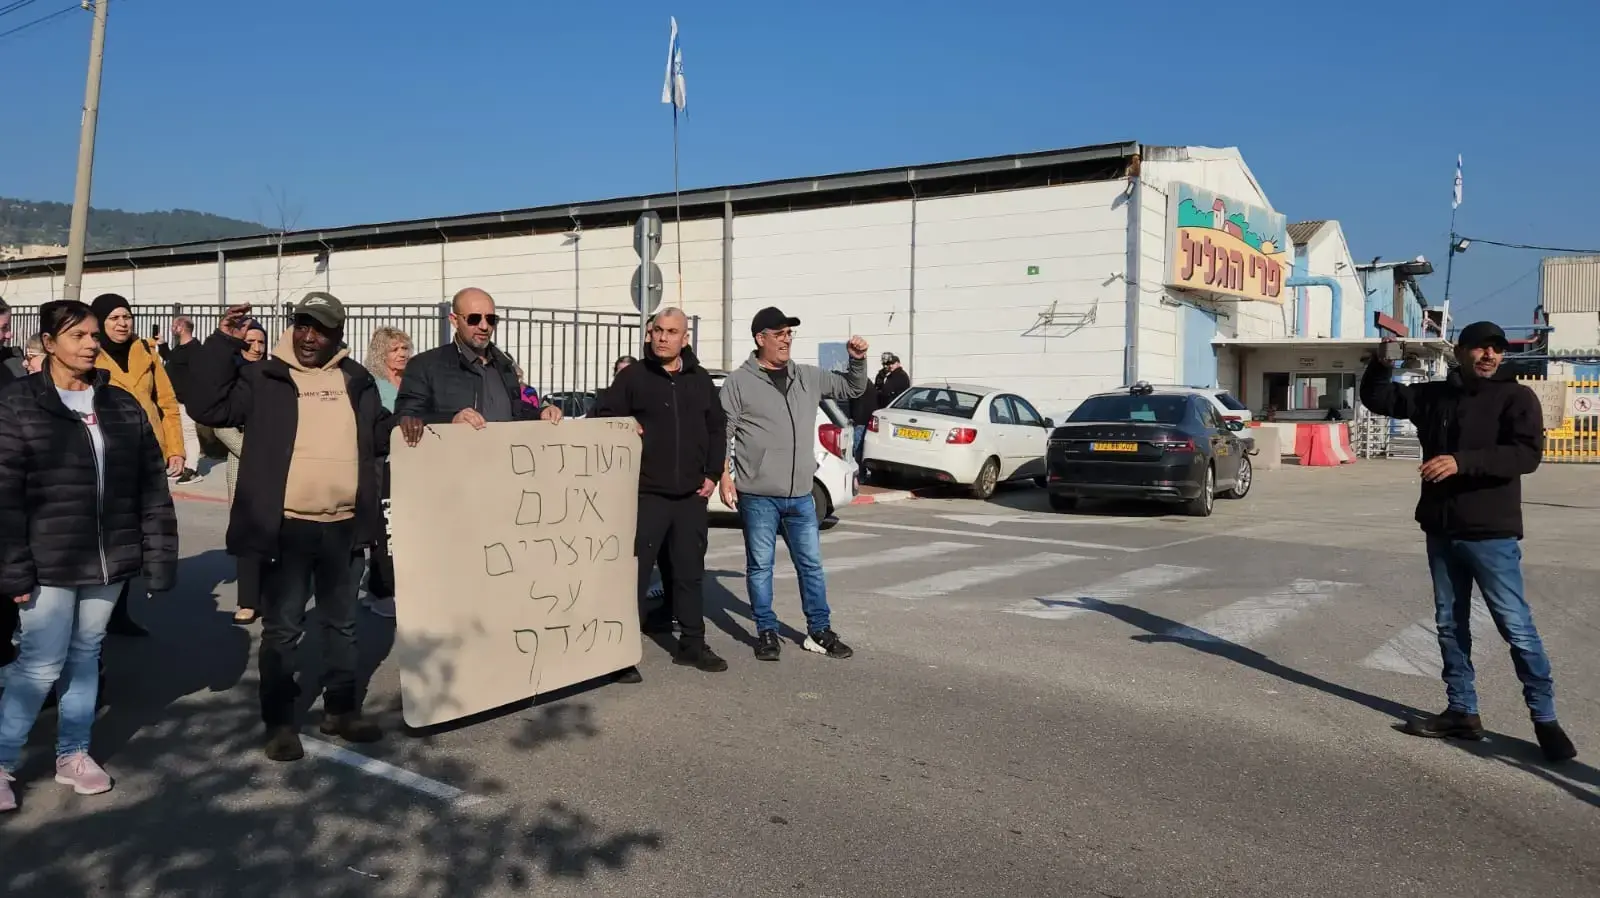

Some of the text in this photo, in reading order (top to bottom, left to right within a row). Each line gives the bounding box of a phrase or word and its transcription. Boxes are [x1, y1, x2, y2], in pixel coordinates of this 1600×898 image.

[1181, 230, 1281, 297] פרי הגליל
[511, 445, 632, 476] העובדים
[515, 488, 604, 525] אינם
[484, 534, 620, 576] מוצרים
[530, 580, 582, 614] על
[513, 618, 624, 684] המדף
